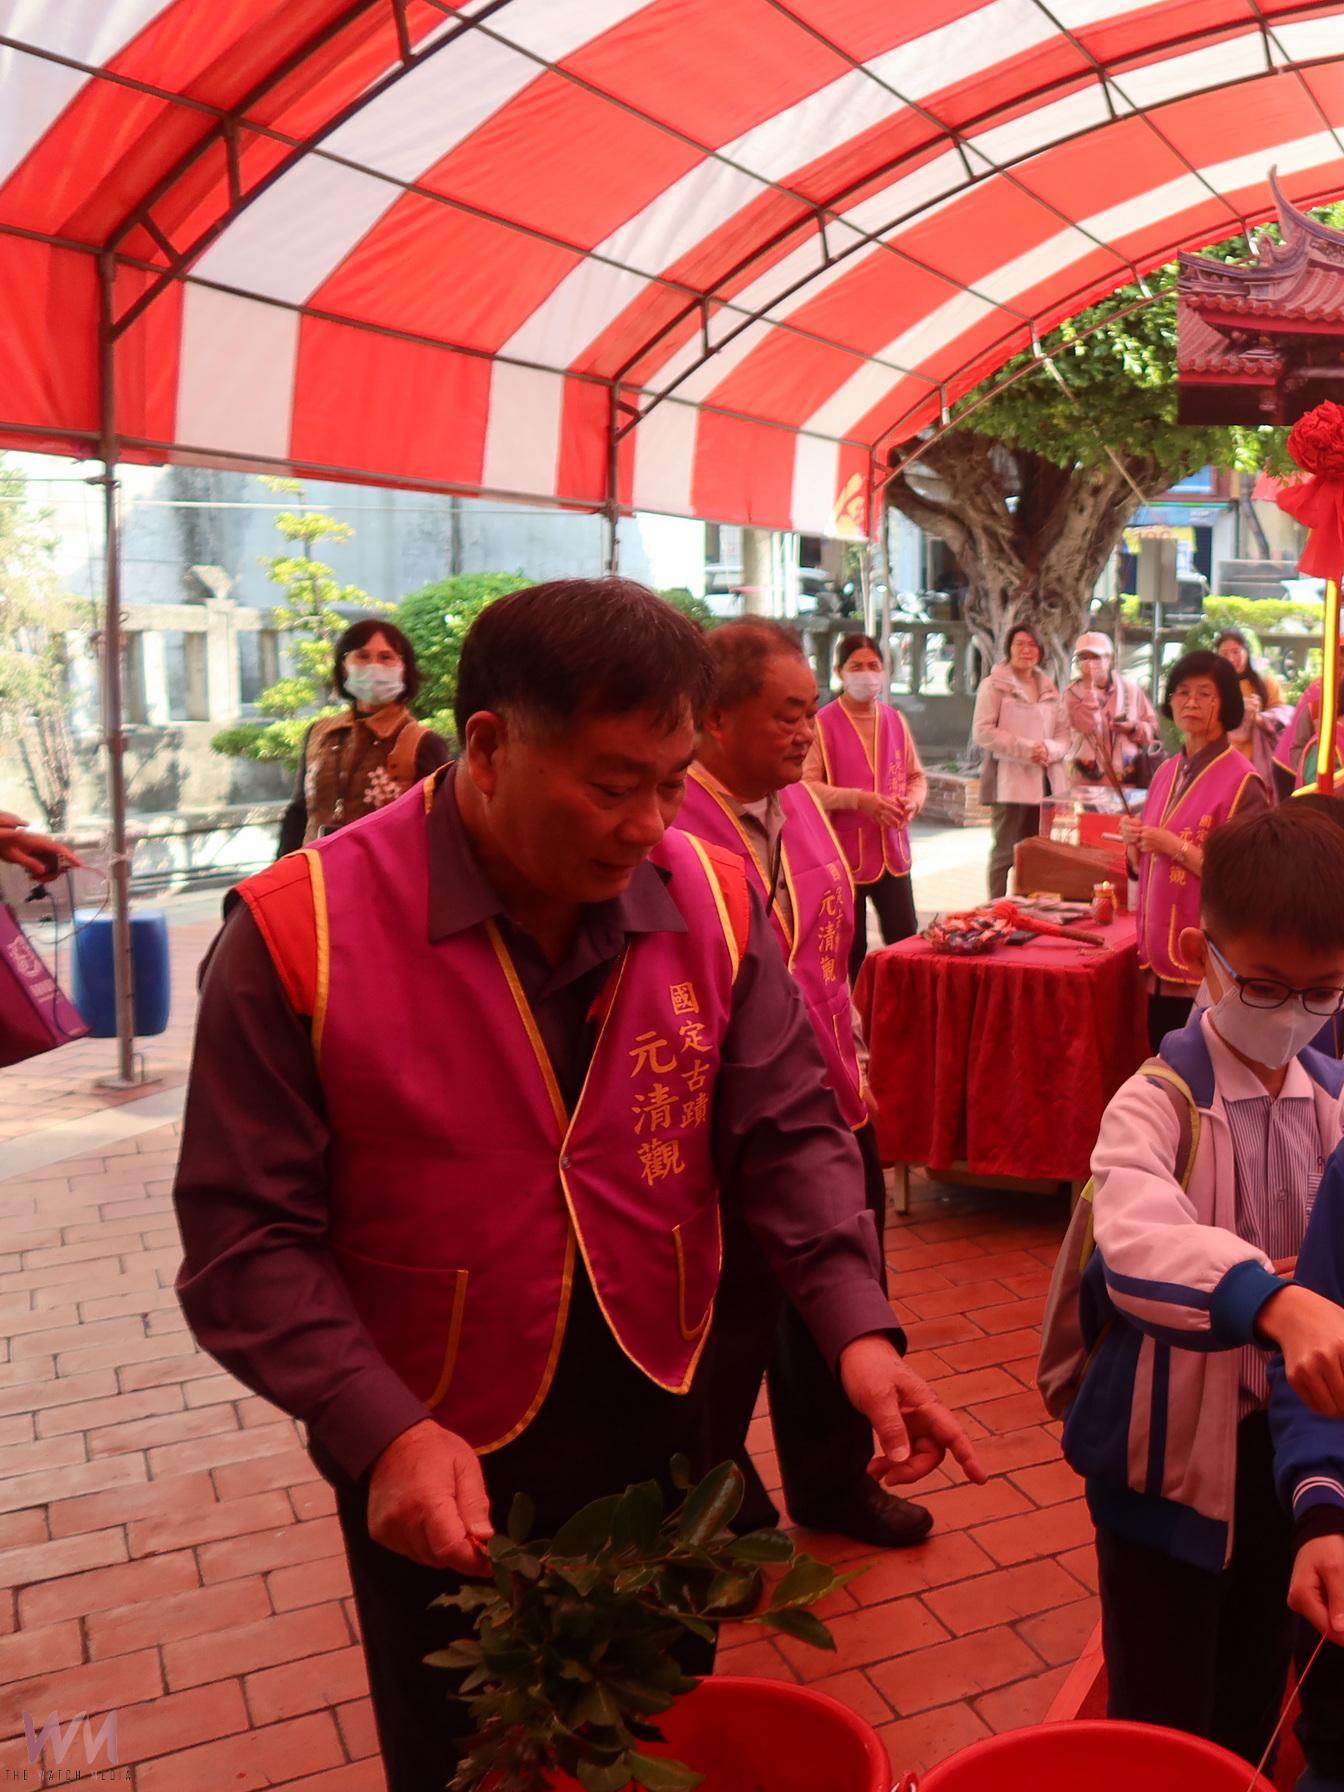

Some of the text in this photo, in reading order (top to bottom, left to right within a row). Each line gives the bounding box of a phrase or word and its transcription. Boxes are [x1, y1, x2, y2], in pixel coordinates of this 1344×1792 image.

[628, 1030, 686, 1186] 元清觀
[669, 981, 714, 1129] 國定古蹟
